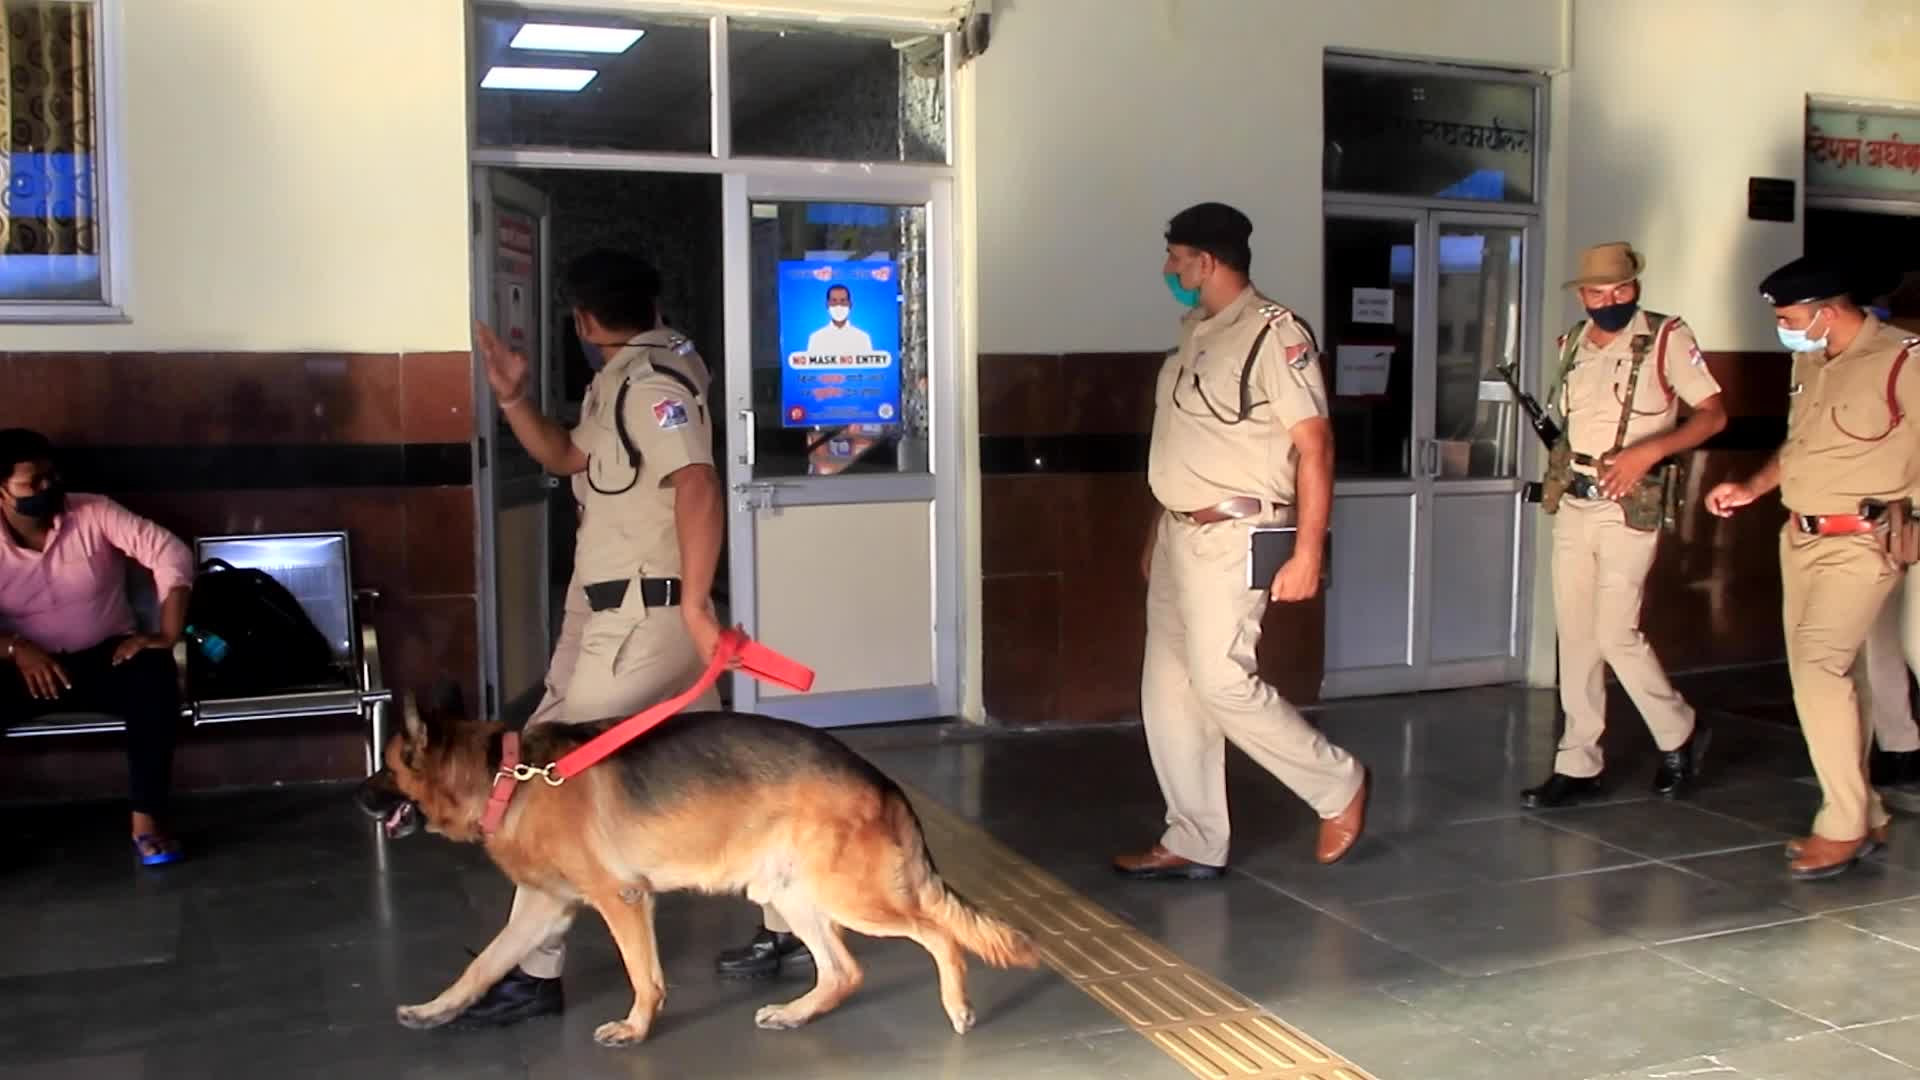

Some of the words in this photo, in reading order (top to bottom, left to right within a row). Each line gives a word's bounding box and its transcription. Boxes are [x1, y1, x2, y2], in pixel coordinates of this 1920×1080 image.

[792, 355, 806, 365] NO
[809, 355, 836, 365] MASK
[840, 355, 853, 365] NO
[856, 354, 887, 365] ENTRY
